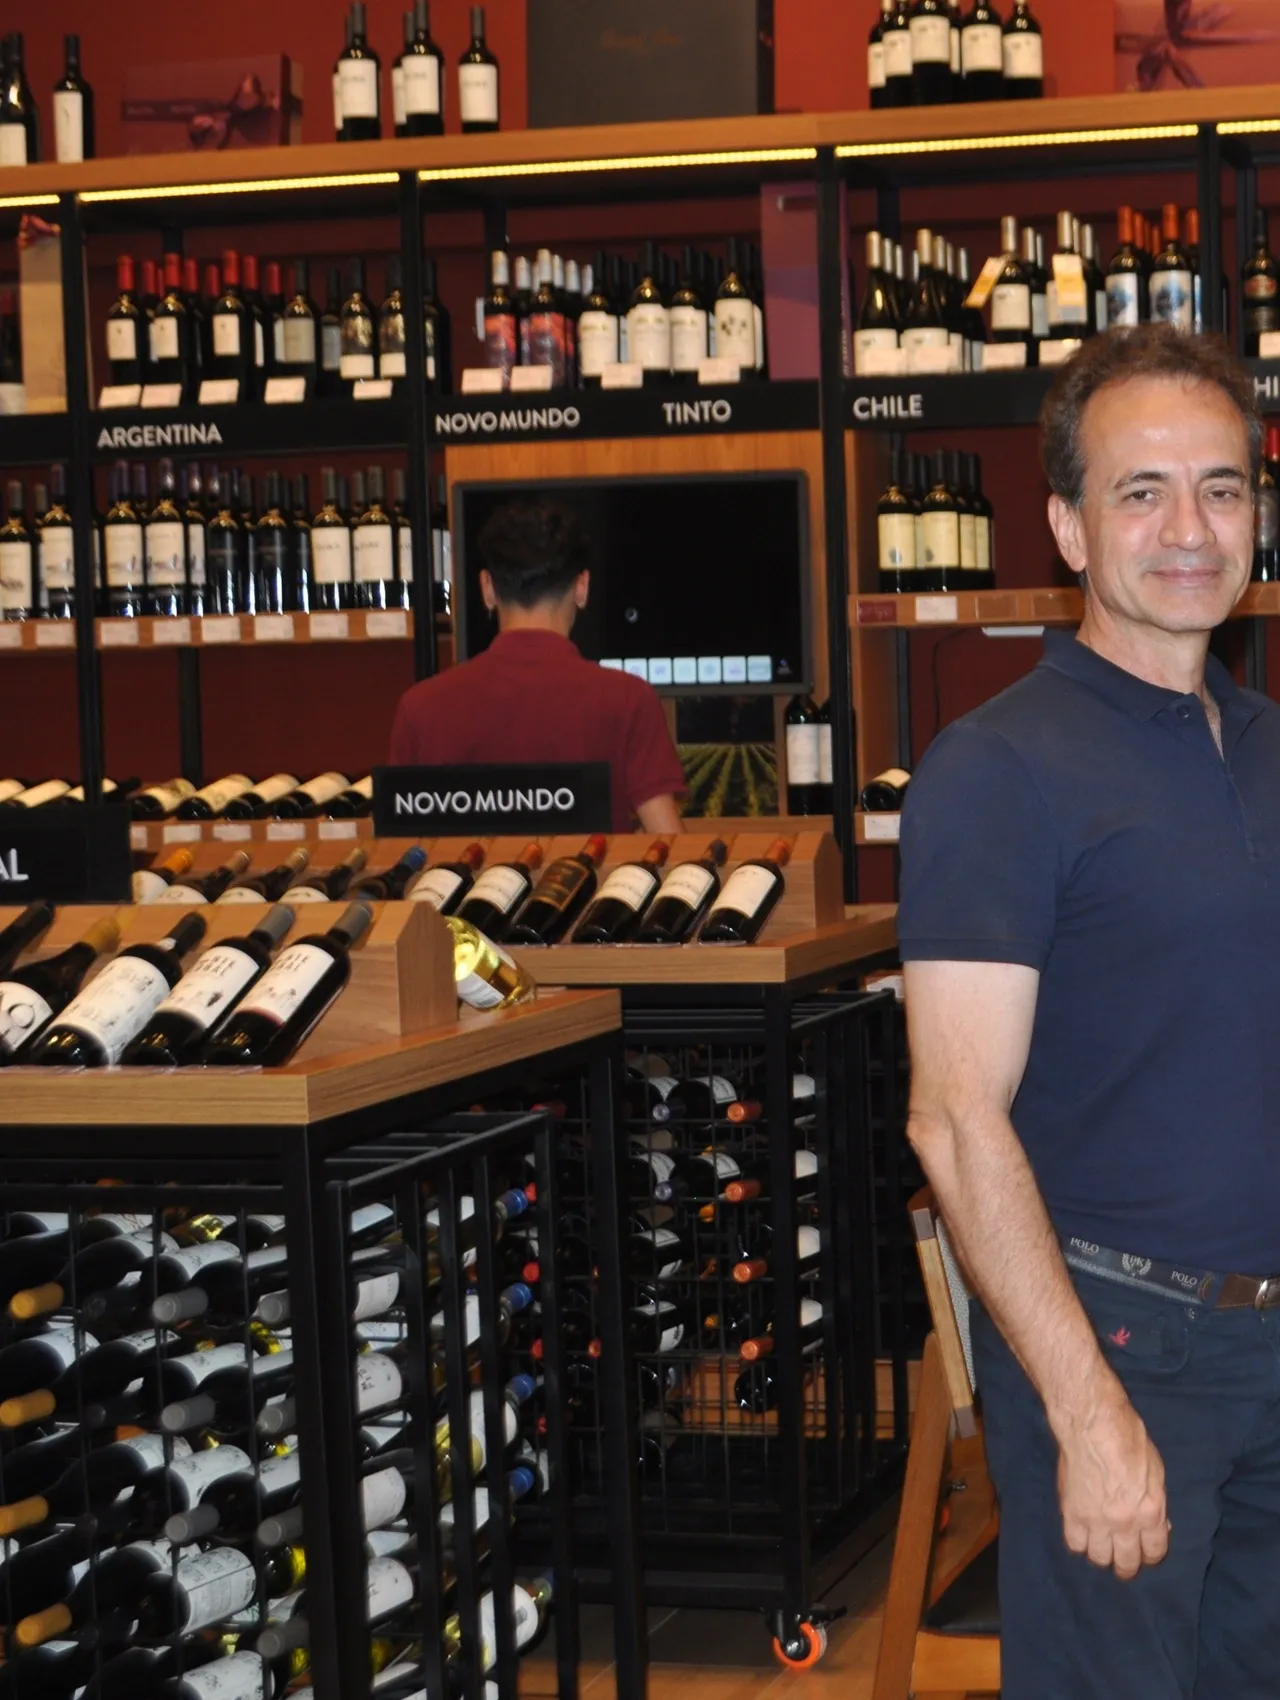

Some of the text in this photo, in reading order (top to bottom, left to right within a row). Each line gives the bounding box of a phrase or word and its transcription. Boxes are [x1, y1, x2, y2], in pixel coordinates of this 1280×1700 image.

[662, 399, 732, 425] TINTO
[852, 394, 924, 420] CHILE
[97, 422, 223, 448] ARGENTINA
[1070, 1237, 1099, 1254] POLO
[1171, 1270, 1198, 1286] POLO
